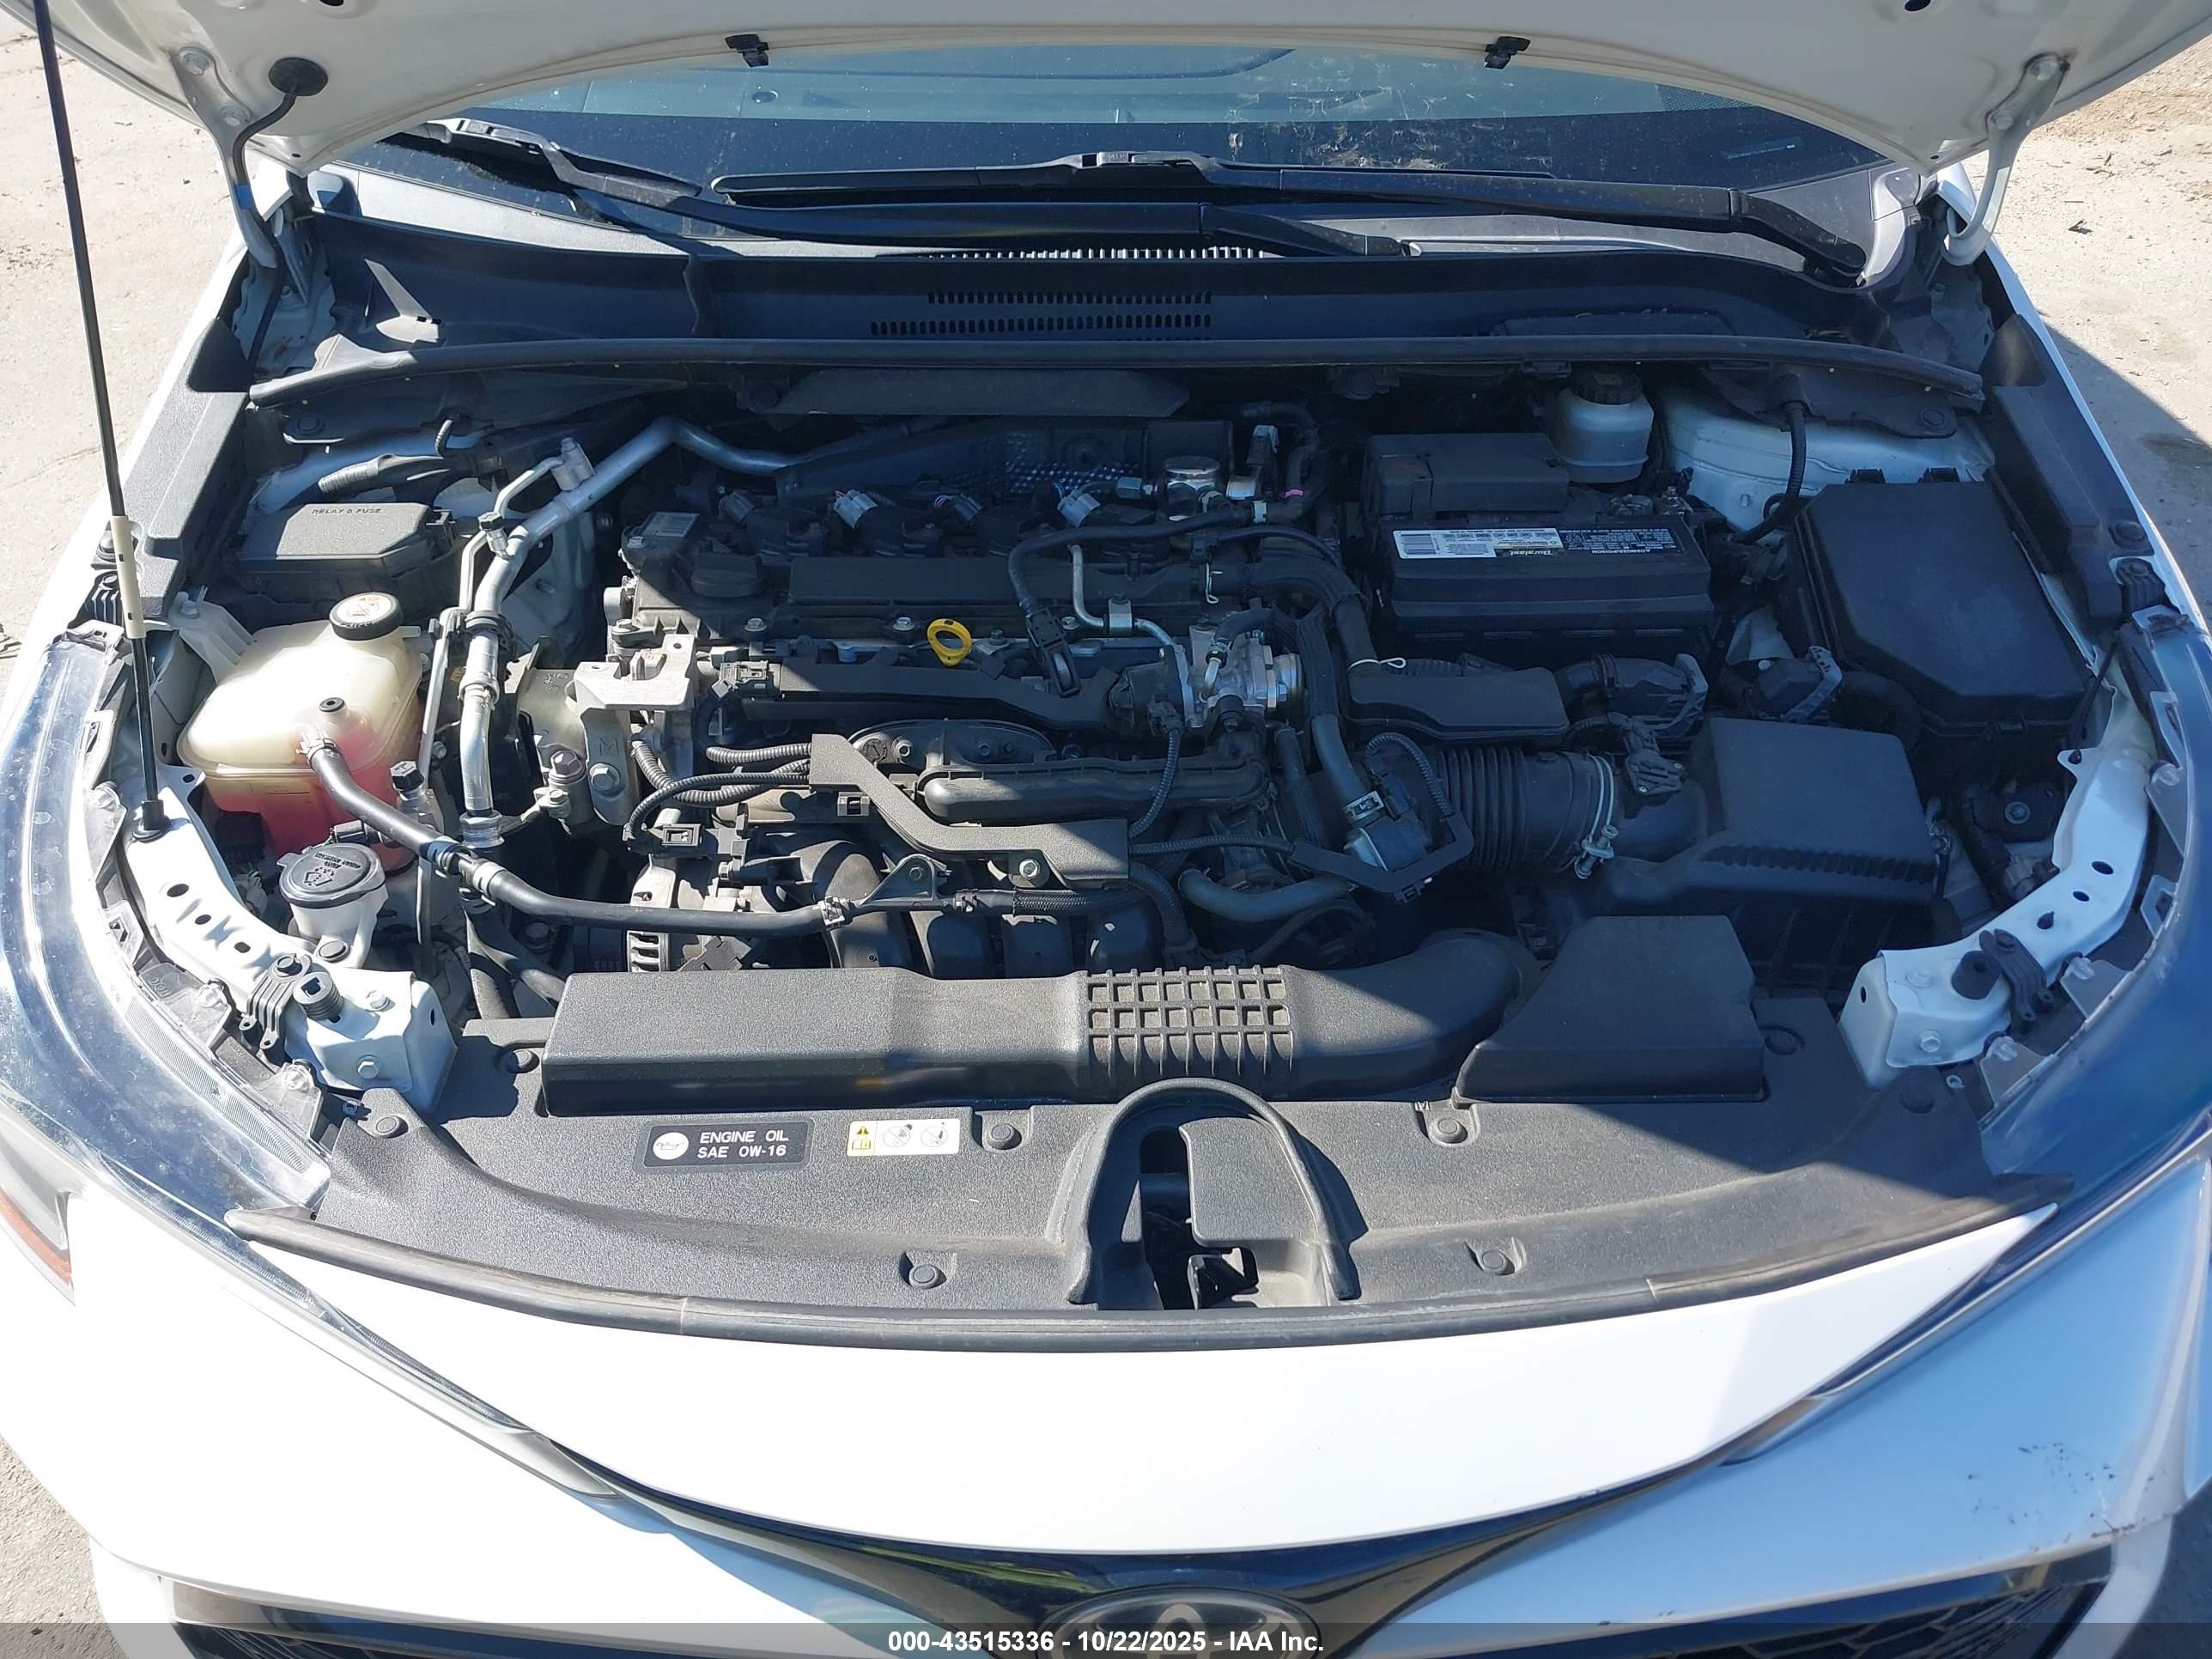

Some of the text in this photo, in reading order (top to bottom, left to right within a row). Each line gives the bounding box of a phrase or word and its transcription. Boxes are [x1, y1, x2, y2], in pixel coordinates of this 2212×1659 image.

[700, 1130, 789, 1144] ENGINE OIL
[696, 1145, 787, 1158] SAE 0W-16
